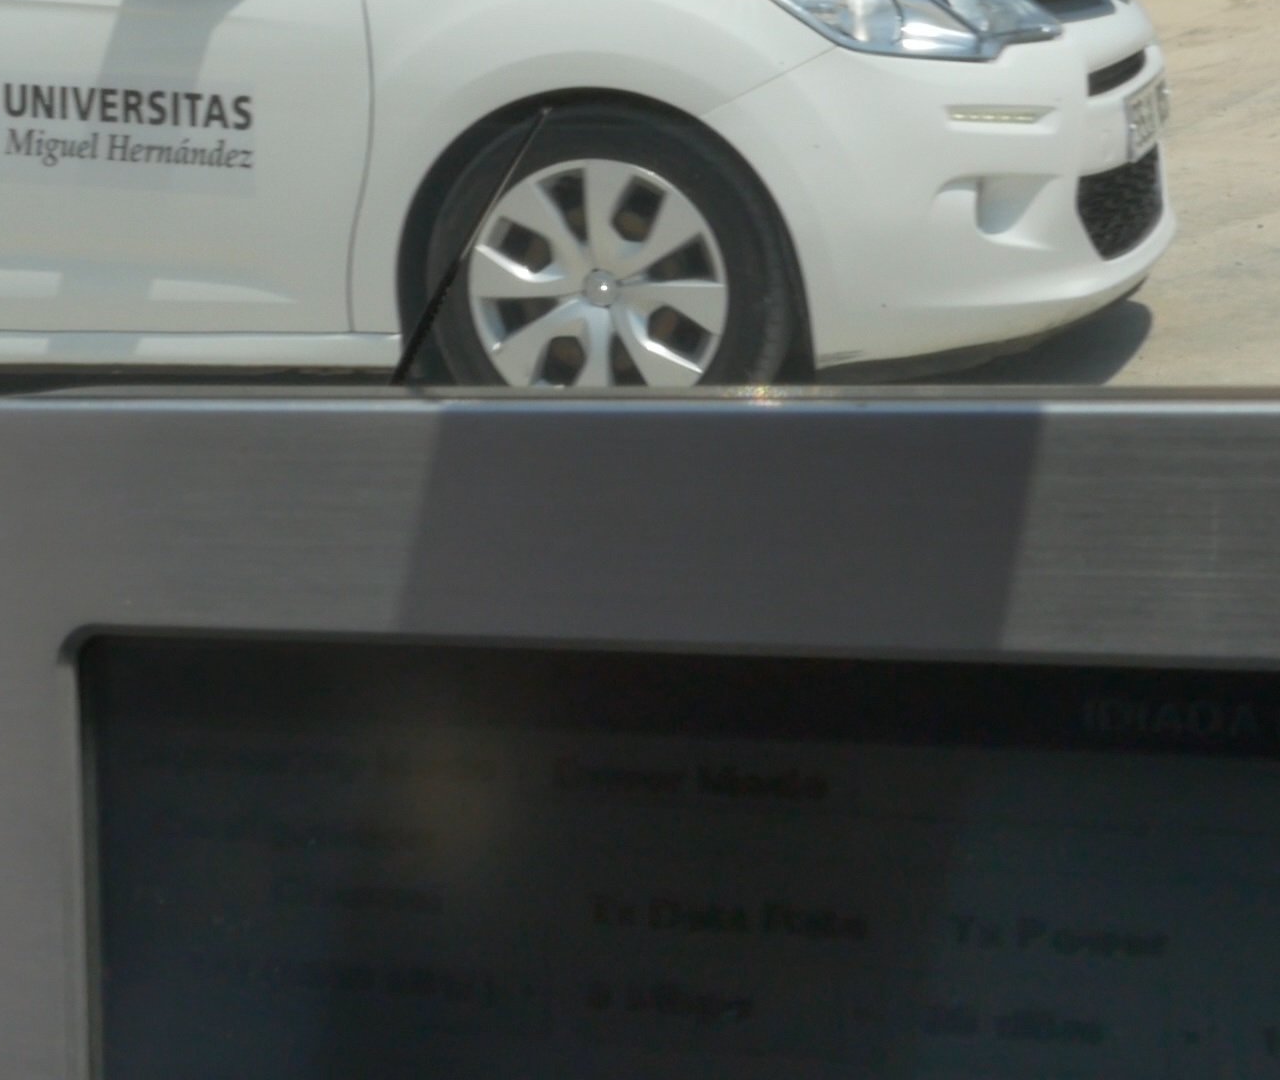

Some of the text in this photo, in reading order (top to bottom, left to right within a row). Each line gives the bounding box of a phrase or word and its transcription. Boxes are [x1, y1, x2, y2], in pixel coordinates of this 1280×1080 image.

[3, 82, 254, 131] UNIVERSITAS
[4, 128, 255, 170] Miguel Hernández
